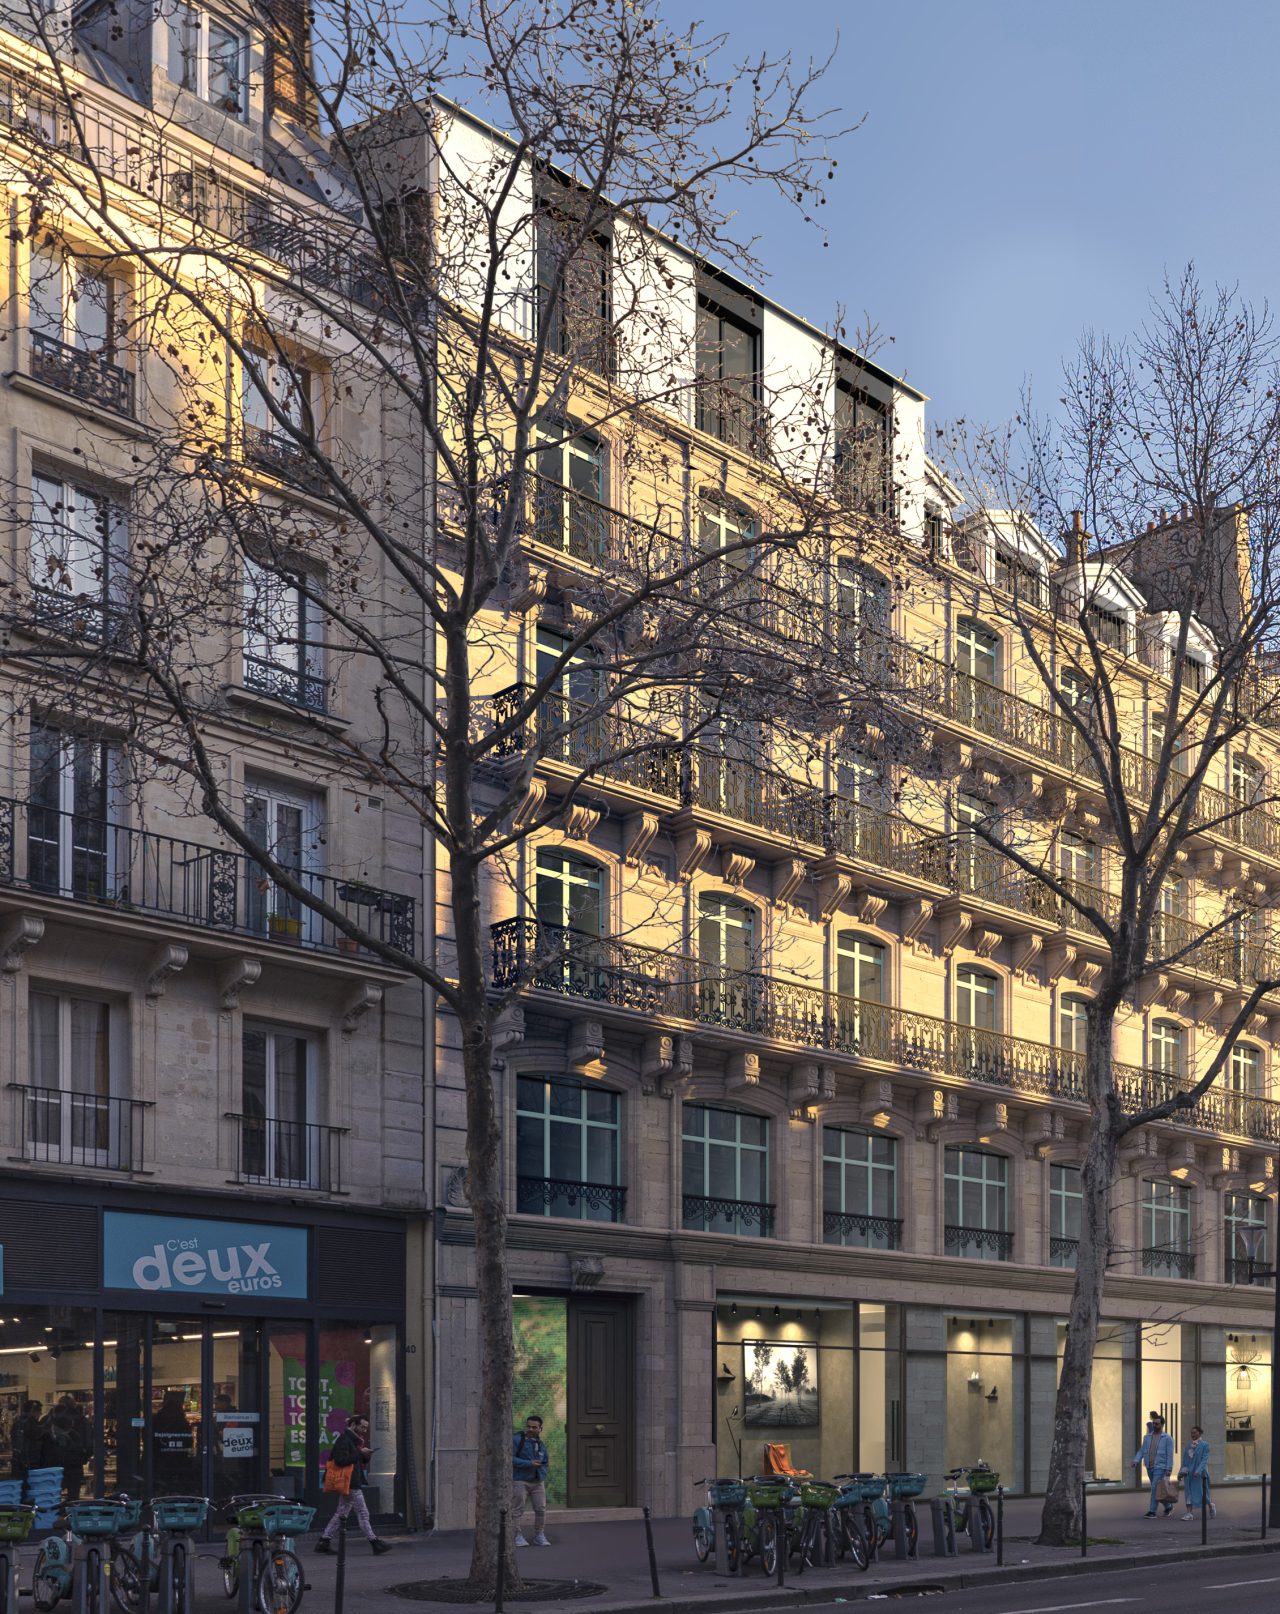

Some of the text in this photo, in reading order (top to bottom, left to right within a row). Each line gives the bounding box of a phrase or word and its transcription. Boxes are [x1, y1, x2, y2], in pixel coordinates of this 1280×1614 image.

[166, 1237, 200, 1251] C'est
[132, 1242, 278, 1291] deux
[227, 1274, 282, 1294] euros
[288, 1376, 333, 1395] TOT,
[288, 1394, 333, 1412] TOT,
[289, 1412, 329, 1427] TOT
[222, 1437, 254, 1448] deux
